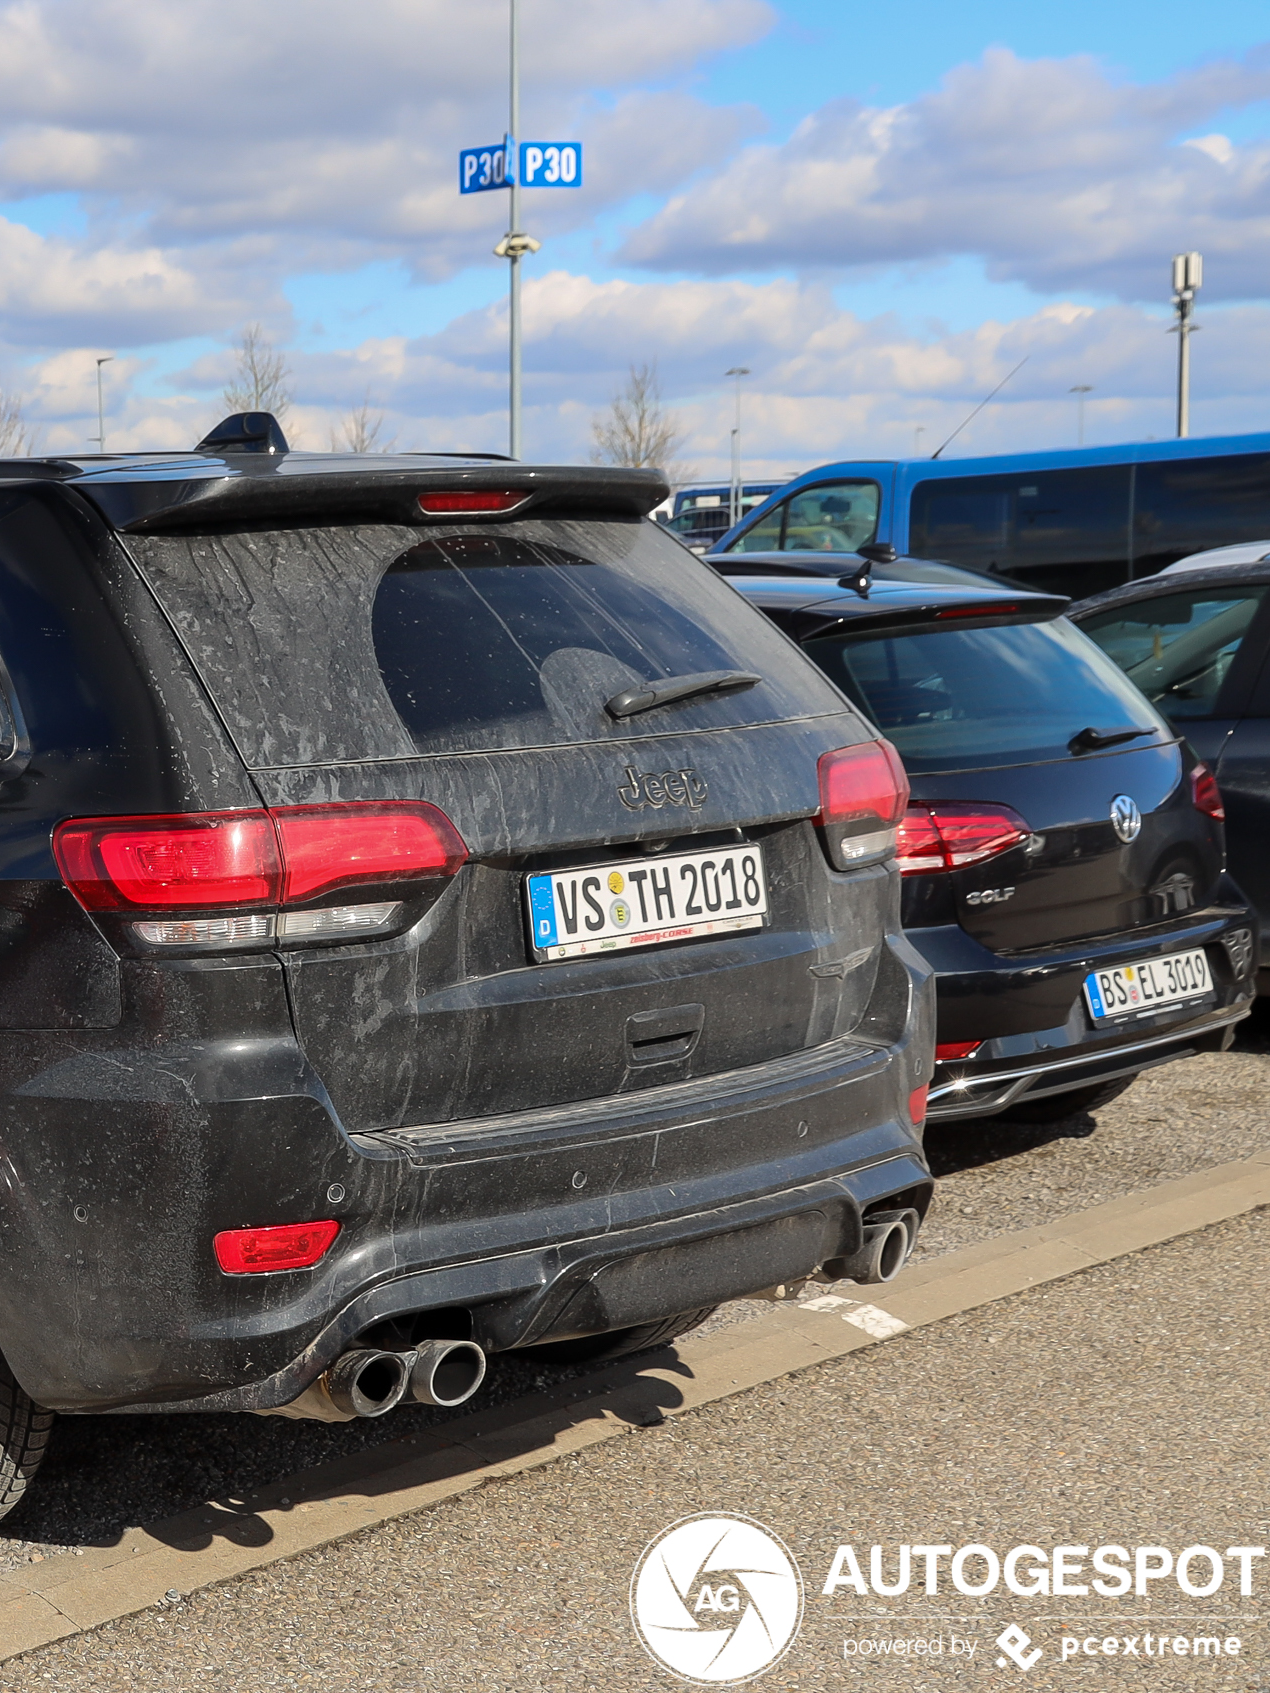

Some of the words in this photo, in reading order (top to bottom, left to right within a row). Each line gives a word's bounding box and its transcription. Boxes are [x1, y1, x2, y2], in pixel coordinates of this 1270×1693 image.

[464, 150, 504, 188] P30
[526, 147, 576, 182] P30
[617, 765, 709, 812] Jeep
[556, 877, 605, 934] VS
[628, 867, 675, 922] TH
[680, 855, 760, 915] 2018
[966, 887, 1015, 905] GOLF
[541, 919, 551, 936] D
[1100, 972, 1128, 1008] BS
[1137, 965, 1164, 1000] EL
[1163, 954, 1206, 993] 3019
